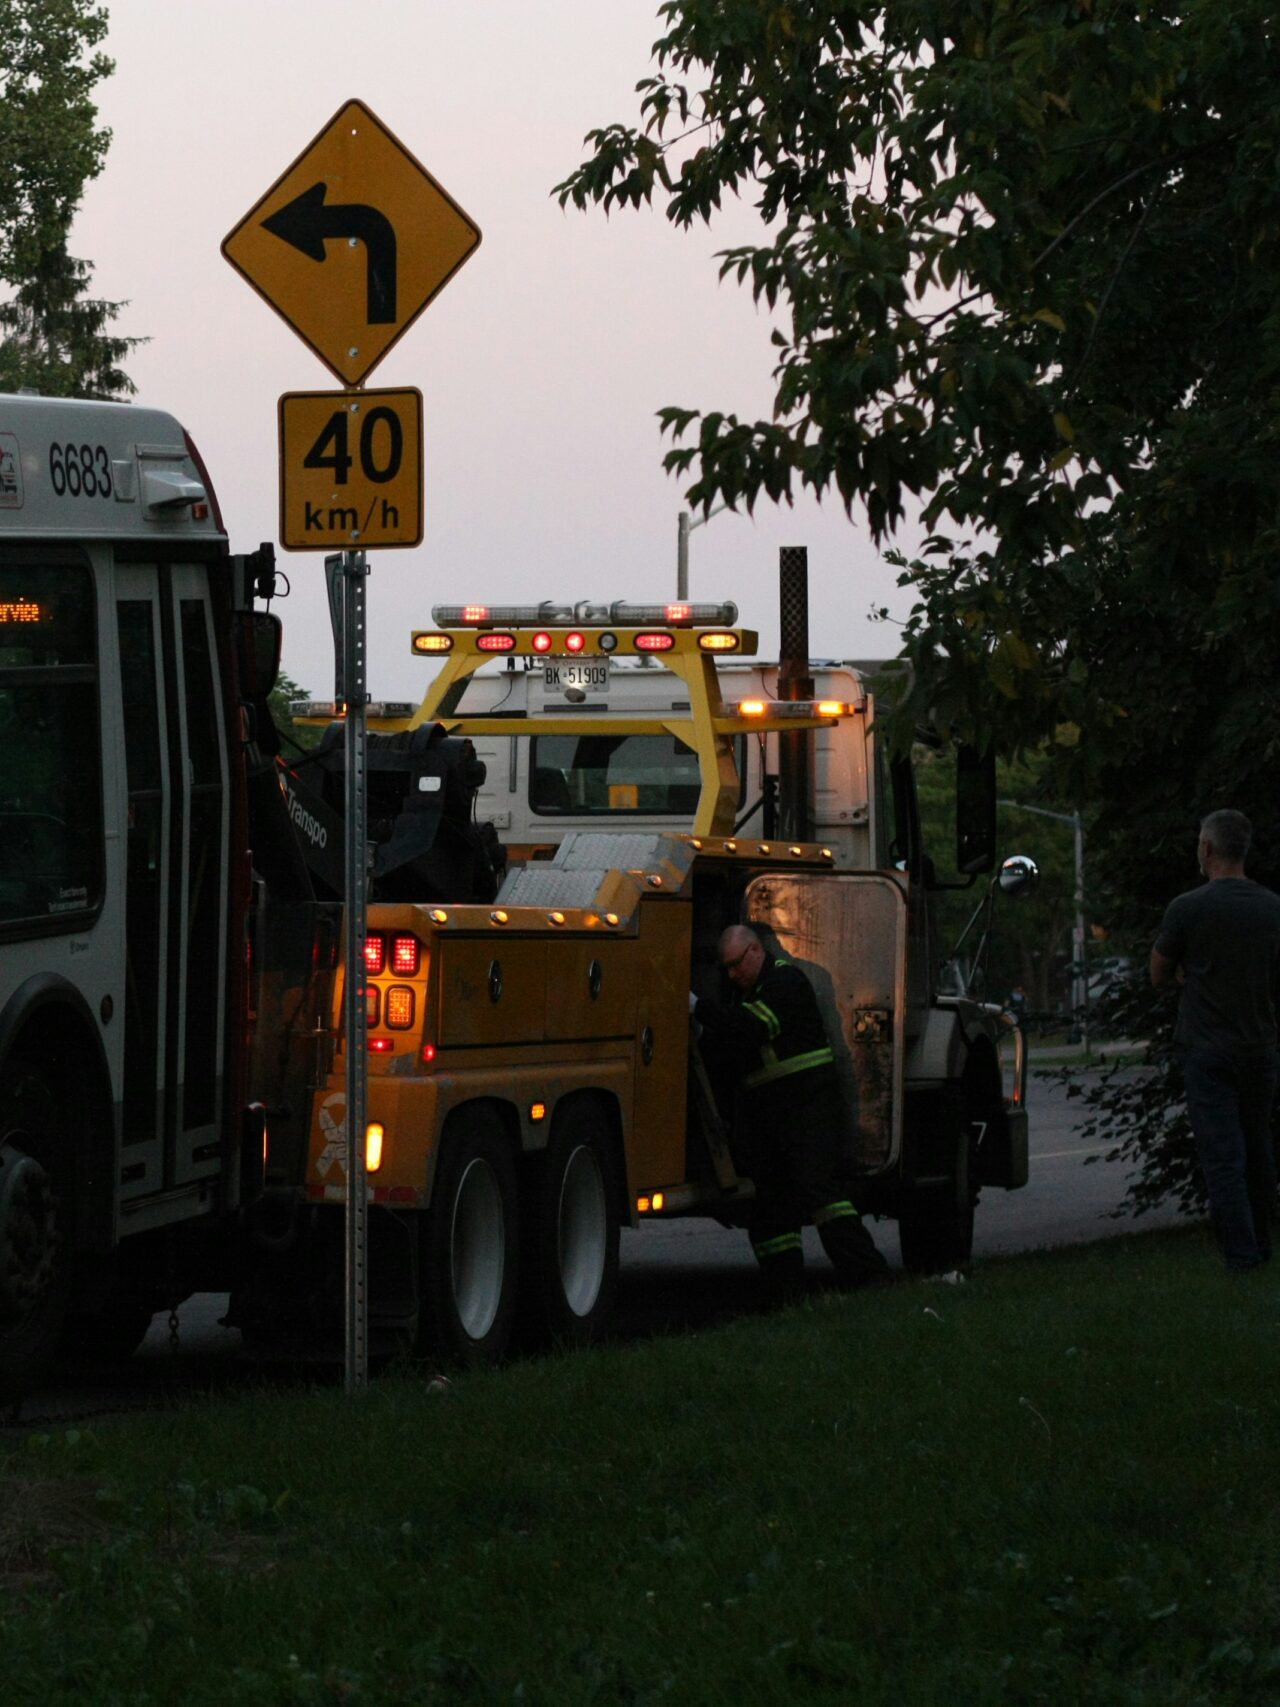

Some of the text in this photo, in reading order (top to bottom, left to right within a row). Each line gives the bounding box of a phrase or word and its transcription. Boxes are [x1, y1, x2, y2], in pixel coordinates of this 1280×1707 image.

[49, 442, 112, 498] 6683
[304, 406, 402, 485] 40
[305, 496, 398, 533] km/h
[286, 786, 328, 849] Transpo
